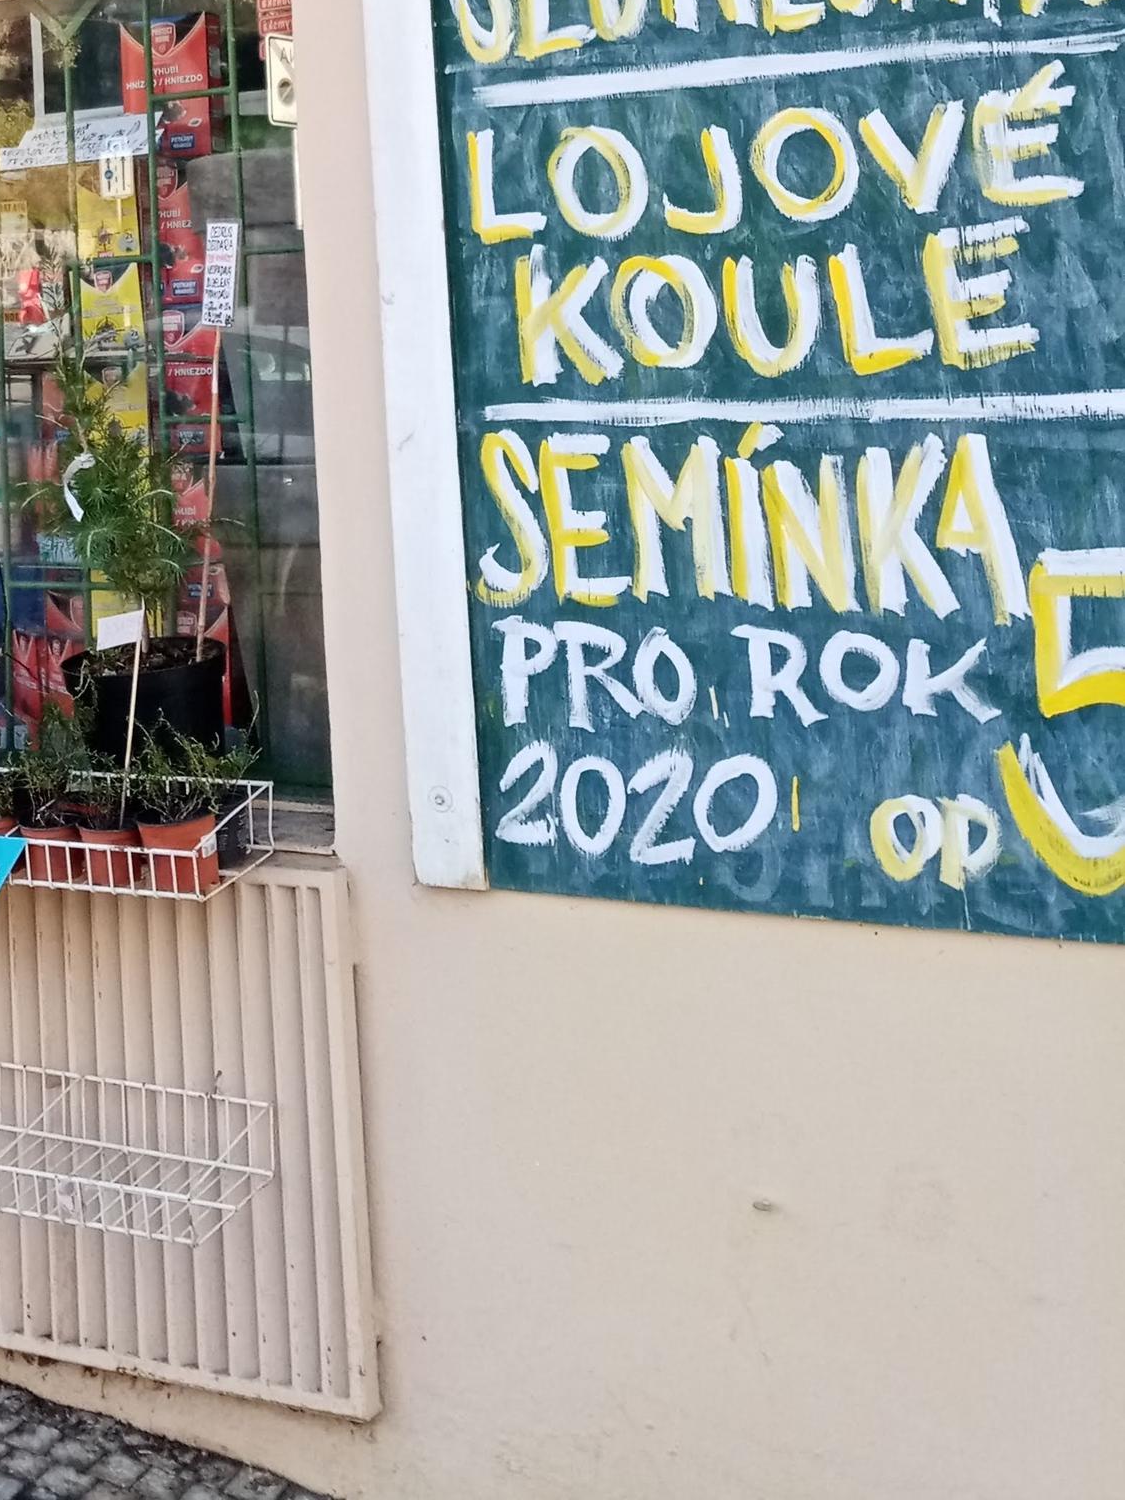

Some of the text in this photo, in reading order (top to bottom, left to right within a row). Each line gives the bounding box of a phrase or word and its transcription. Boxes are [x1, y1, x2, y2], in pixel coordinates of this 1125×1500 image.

[164, 74, 204, 86] HNIEZDO
[467, 60, 1085, 243] LOJOVÉ
[515, 215, 1040, 386] KOULE
[476, 421, 1031, 625] SEMÍNKA
[492, 615, 1002, 733] PRO ROK
[495, 740, 777, 866] 2020
